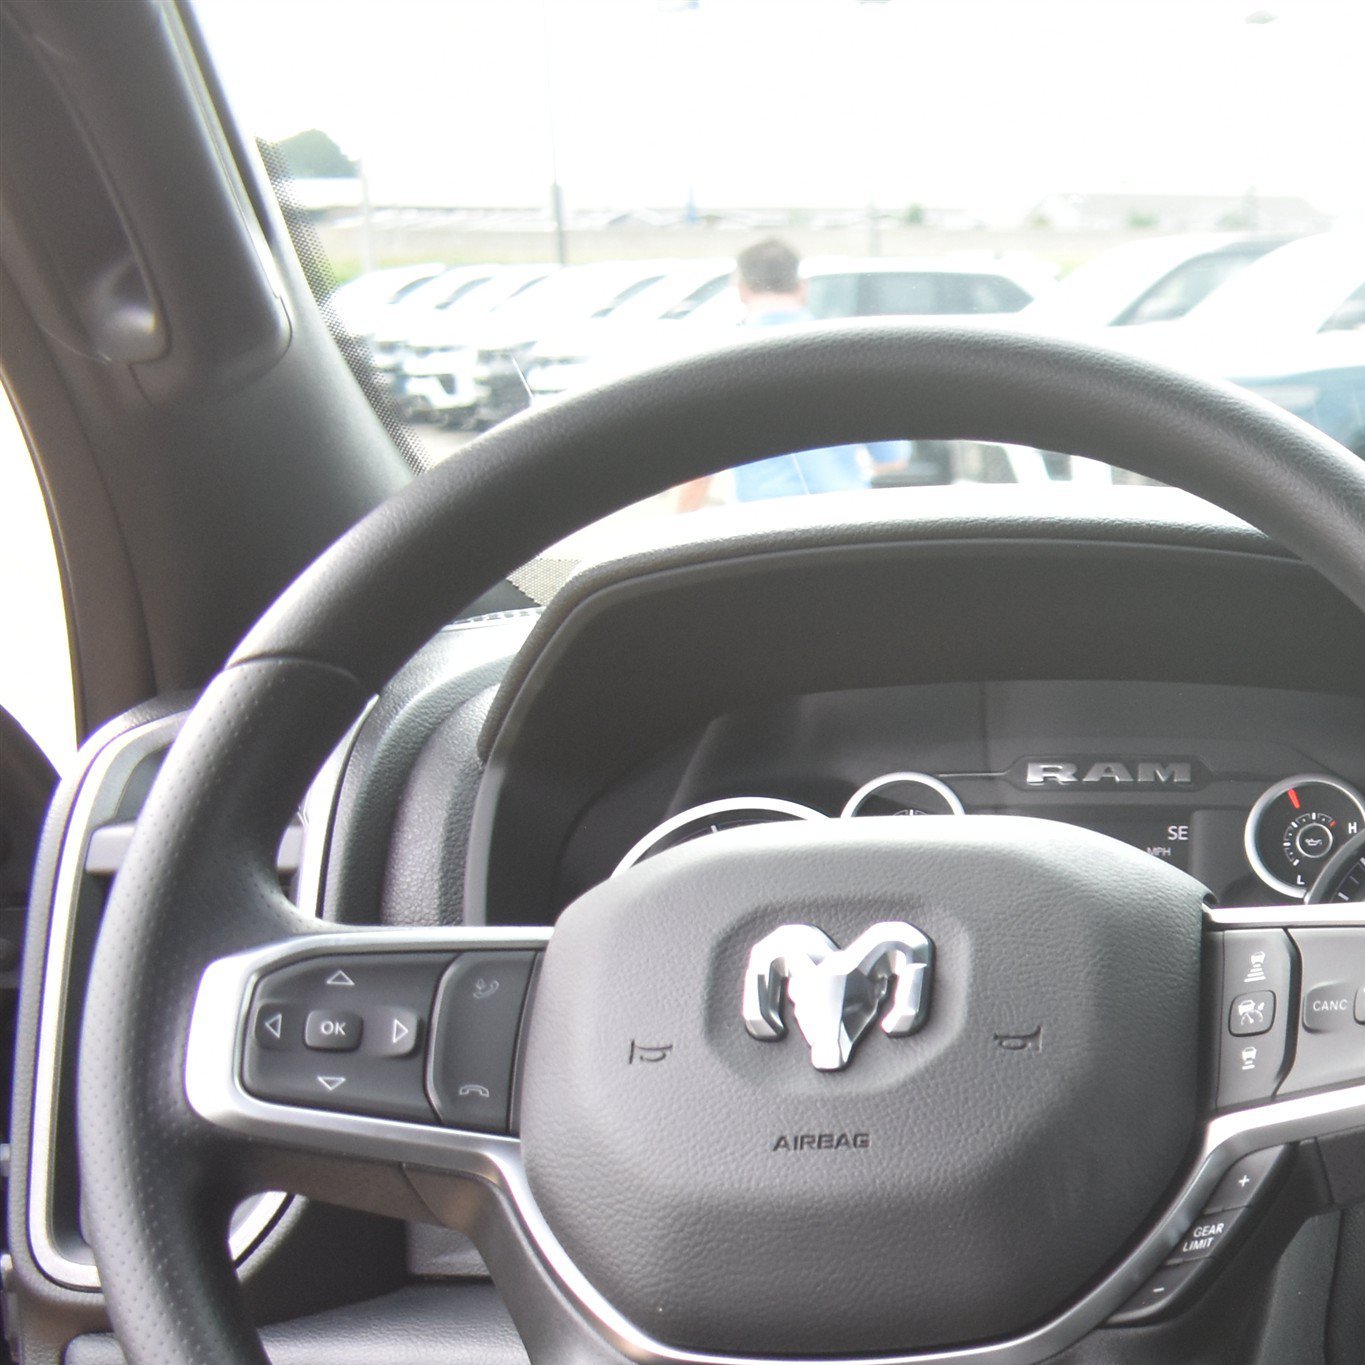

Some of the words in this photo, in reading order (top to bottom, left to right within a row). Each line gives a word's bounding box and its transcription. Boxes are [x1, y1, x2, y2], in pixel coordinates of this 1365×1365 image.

[1025, 761, 1192, 786] RAM
[1167, 824, 1189, 841] SE
[1347, 821, 1358, 834] H
[1146, 846, 1172, 857] MPH
[1296, 874, 1306, 886] L
[1312, 999, 1348, 1012] CANC
[320, 1021, 346, 1036] OK
[772, 1132, 871, 1152] AIRBAG
[1193, 1222, 1225, 1238] GEAR
[1182, 1237, 1215, 1252] LIMIT
